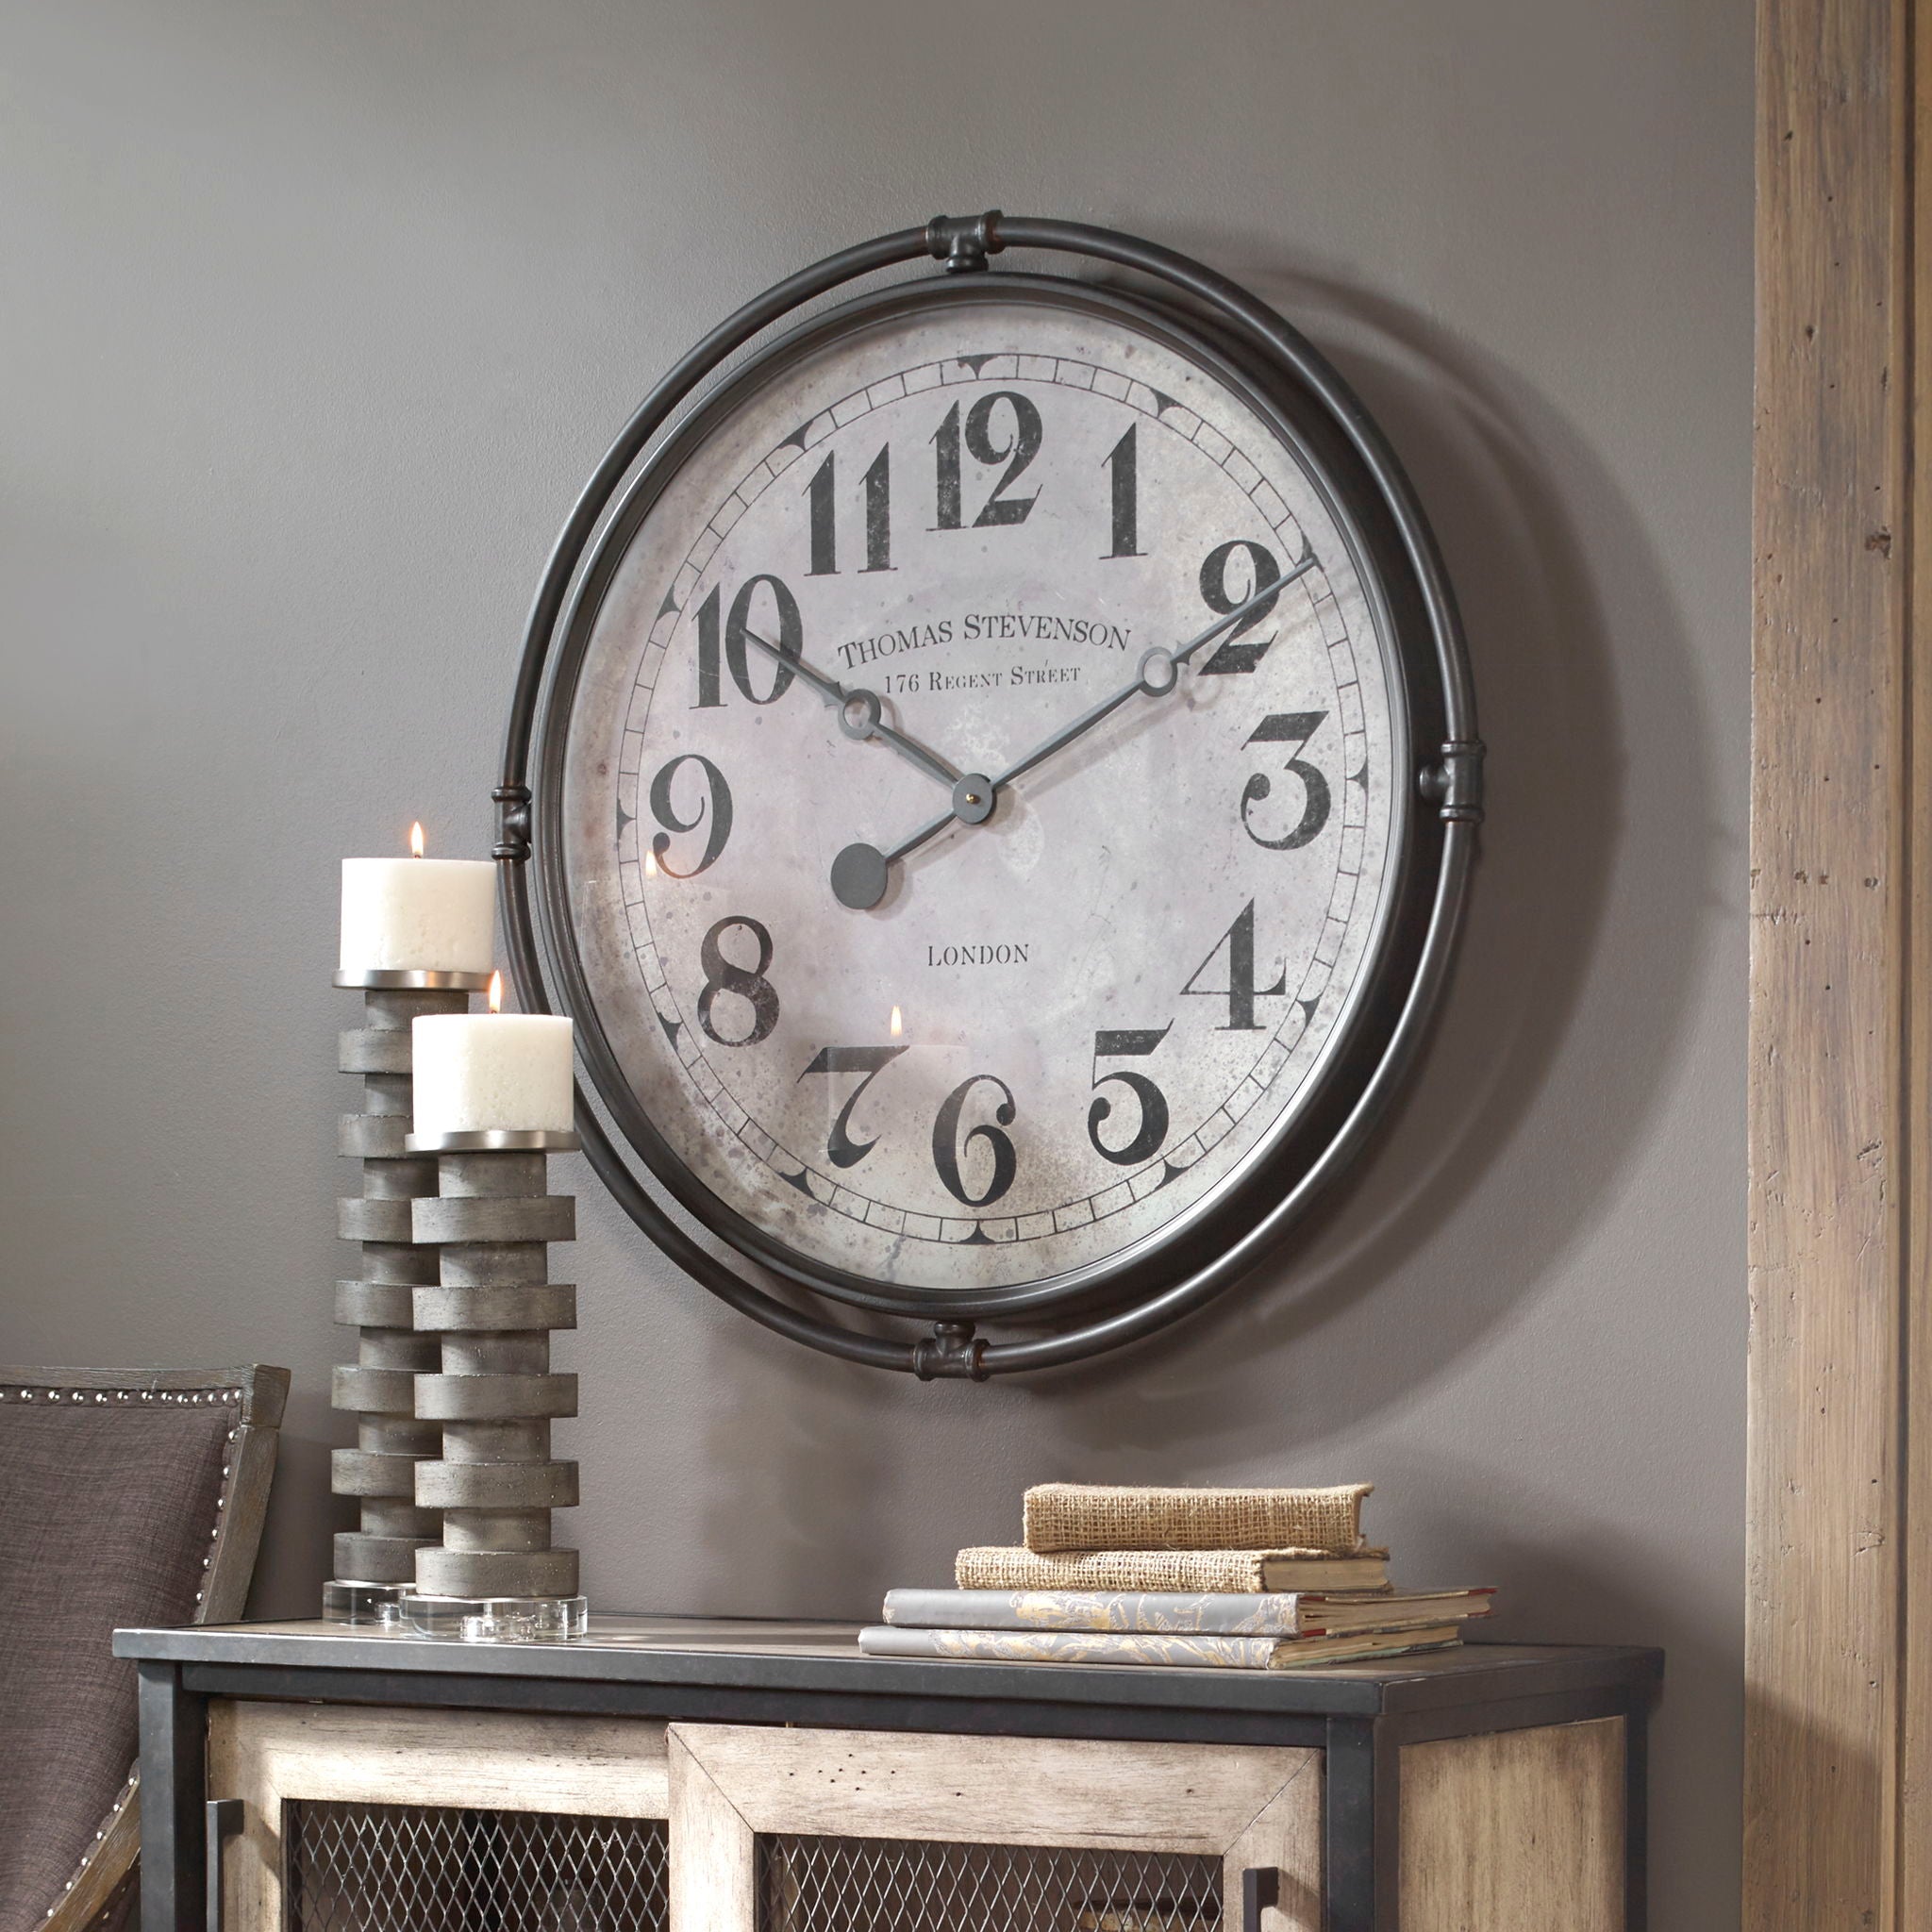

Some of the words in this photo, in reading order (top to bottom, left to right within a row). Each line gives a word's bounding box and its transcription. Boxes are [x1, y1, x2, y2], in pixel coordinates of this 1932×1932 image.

[802, 441, 898, 575] 11
[925, 391, 1043, 531] 12
[1099, 422, 1148, 559] 1
[689, 574, 803, 709] 10
[838, 620, 953, 670] THOMAS
[963, 614, 1131, 652] STEVENSON
[1198, 541, 1281, 675] 2
[885, 674, 920, 694] 176
[650, 754, 733, 879] 9
[1241, 710, 1330, 851] 3
[697, 915, 780, 1046] 8
[928, 944, 1030, 967] LONDON
[1179, 897, 1286, 1032] 4
[797, 1045, 910, 1169] 7
[932, 1074, 1017, 1208] 6
[1088, 1019, 1174, 1166] 5
